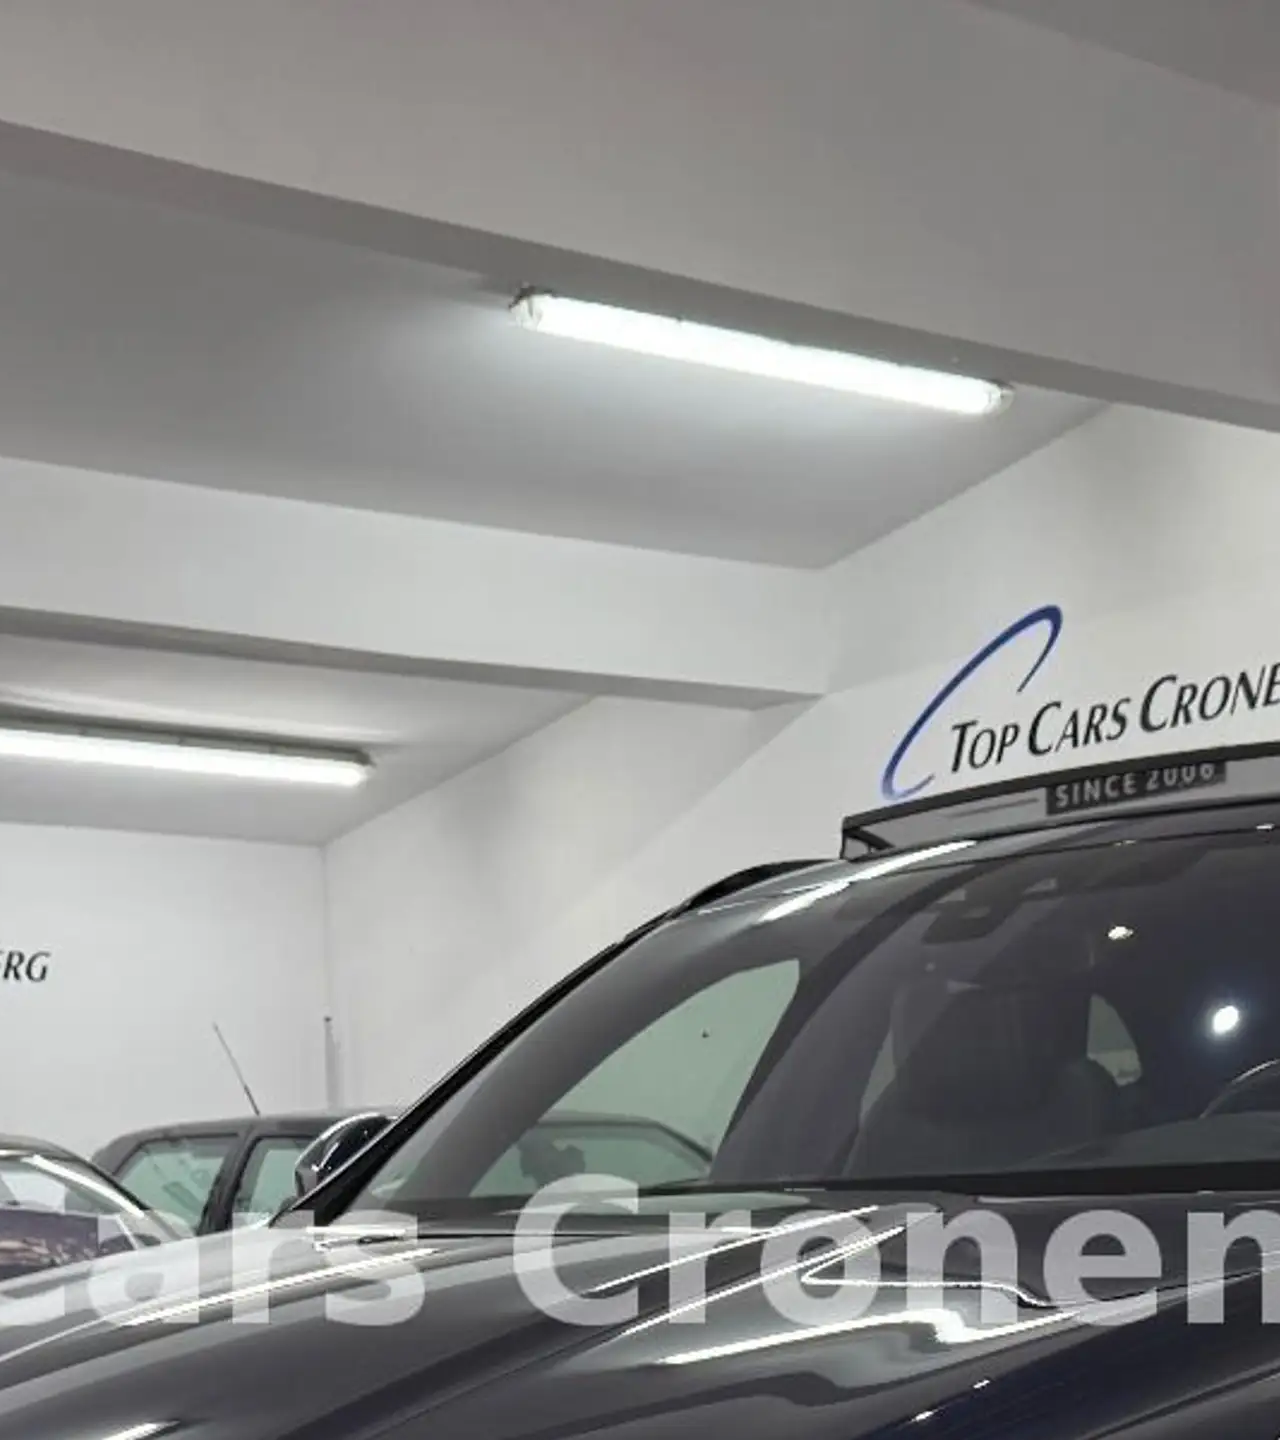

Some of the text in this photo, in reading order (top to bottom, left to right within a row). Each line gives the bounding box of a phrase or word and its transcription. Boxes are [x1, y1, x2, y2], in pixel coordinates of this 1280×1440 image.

[949, 720, 1019, 773] TOP
[1026, 698, 1131, 756] CARS
[1056, 773, 1137, 809] SINCE
